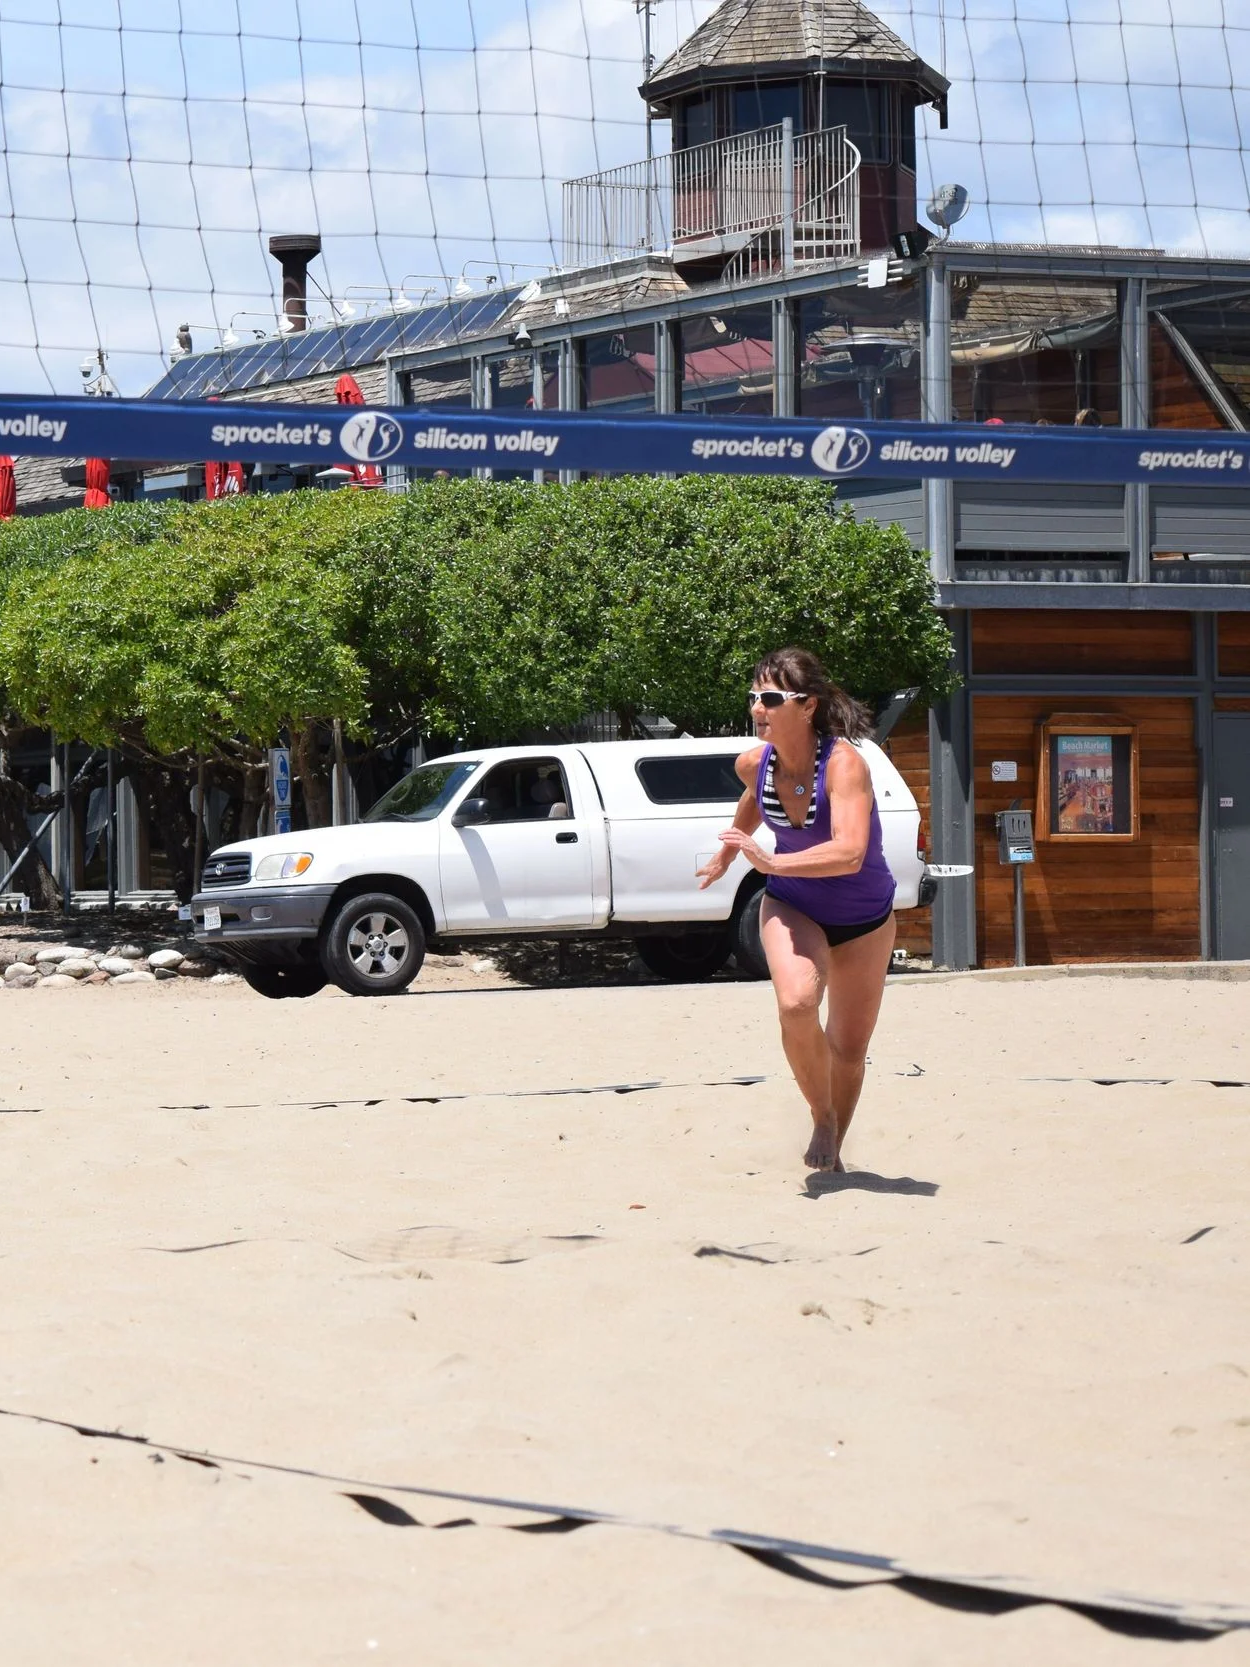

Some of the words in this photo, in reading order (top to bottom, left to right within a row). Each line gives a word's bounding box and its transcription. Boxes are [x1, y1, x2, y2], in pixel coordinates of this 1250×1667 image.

[211, 422, 332, 447] sprocket's
[413, 427, 488, 450] silicon
[494, 430, 560, 457] volley
[691, 436, 804, 459] sprocket's
[879, 440, 949, 462] silicon
[955, 443, 1016, 468] volley
[1138, 448, 1244, 471] sprocket's
[1062, 741, 1082, 750] Beach
[1083, 741, 1108, 750] Market
